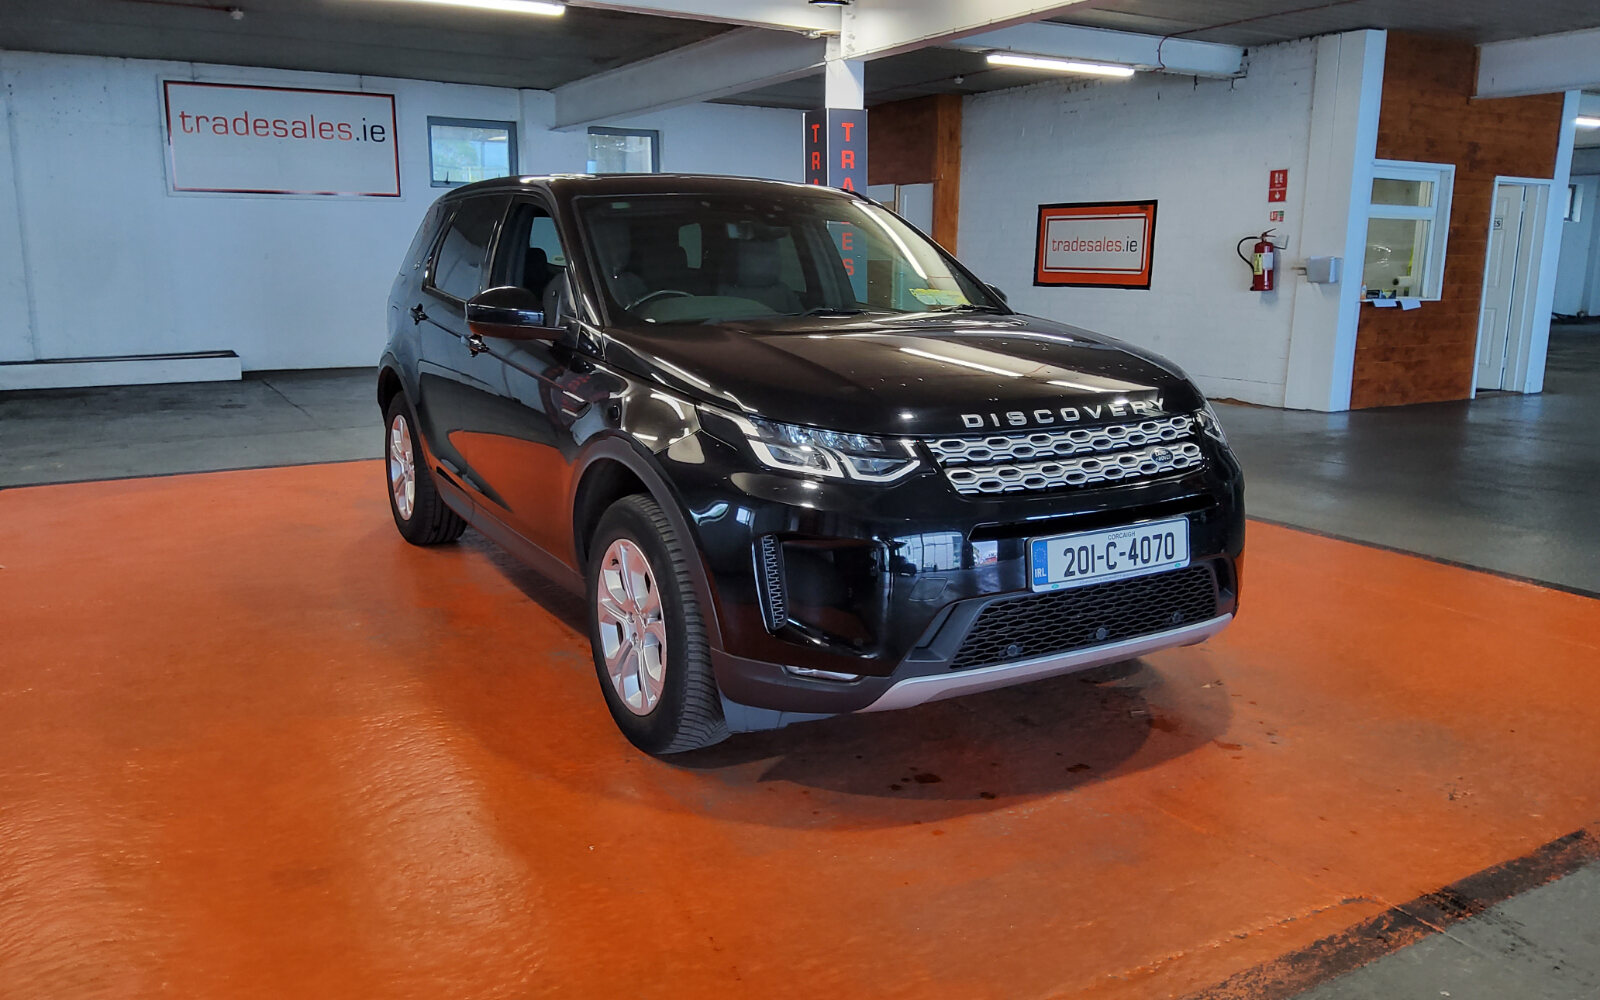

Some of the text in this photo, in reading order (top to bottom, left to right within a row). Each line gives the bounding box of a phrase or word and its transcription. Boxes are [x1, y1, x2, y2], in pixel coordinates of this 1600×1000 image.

[178, 110, 386, 143] tradesales.ie
[1051, 235, 1138, 253] tradesales.ie
[960, 397, 1165, 429] DISCOVERY
[1107, 531, 1136, 541] CORCAIGH
[1063, 532, 1175, 578] 201-C-4070
[1034, 567, 1047, 578] IRL
